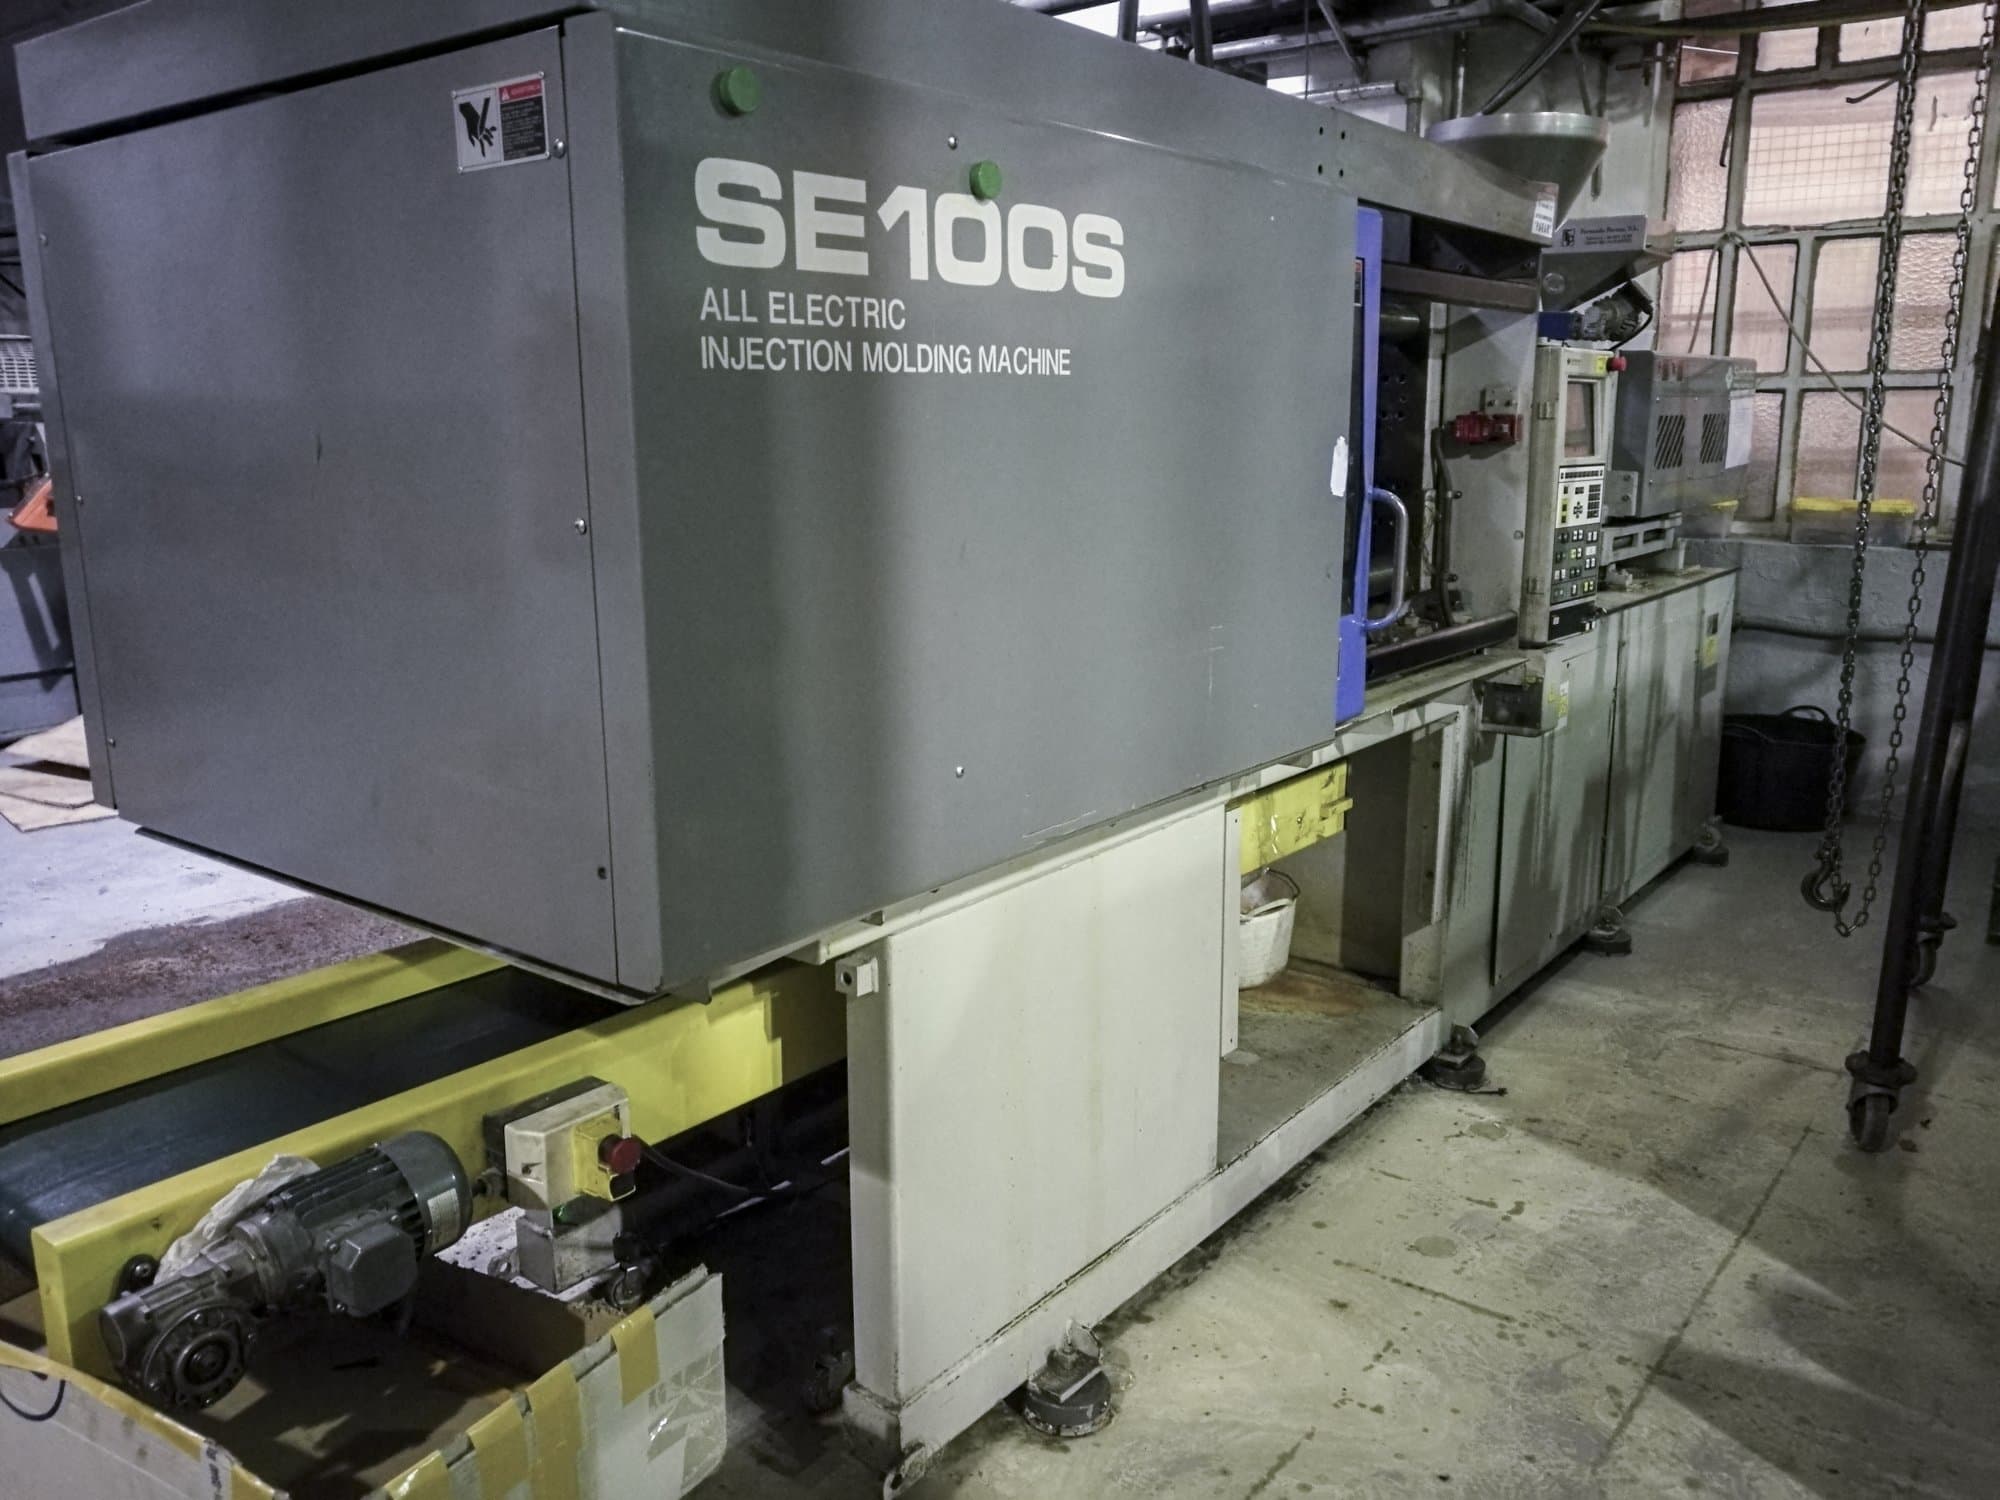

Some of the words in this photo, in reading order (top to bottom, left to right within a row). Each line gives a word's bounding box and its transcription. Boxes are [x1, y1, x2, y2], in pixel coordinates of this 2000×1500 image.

[694, 157, 1126, 299] SE100S
[700, 287, 758, 323] ALL
[768, 290, 907, 330] ELECTRIC
[701, 336, 853, 372] INJECTION
[863, 341, 973, 375] MOLDING
[977, 345, 1072, 376] MACHINE
